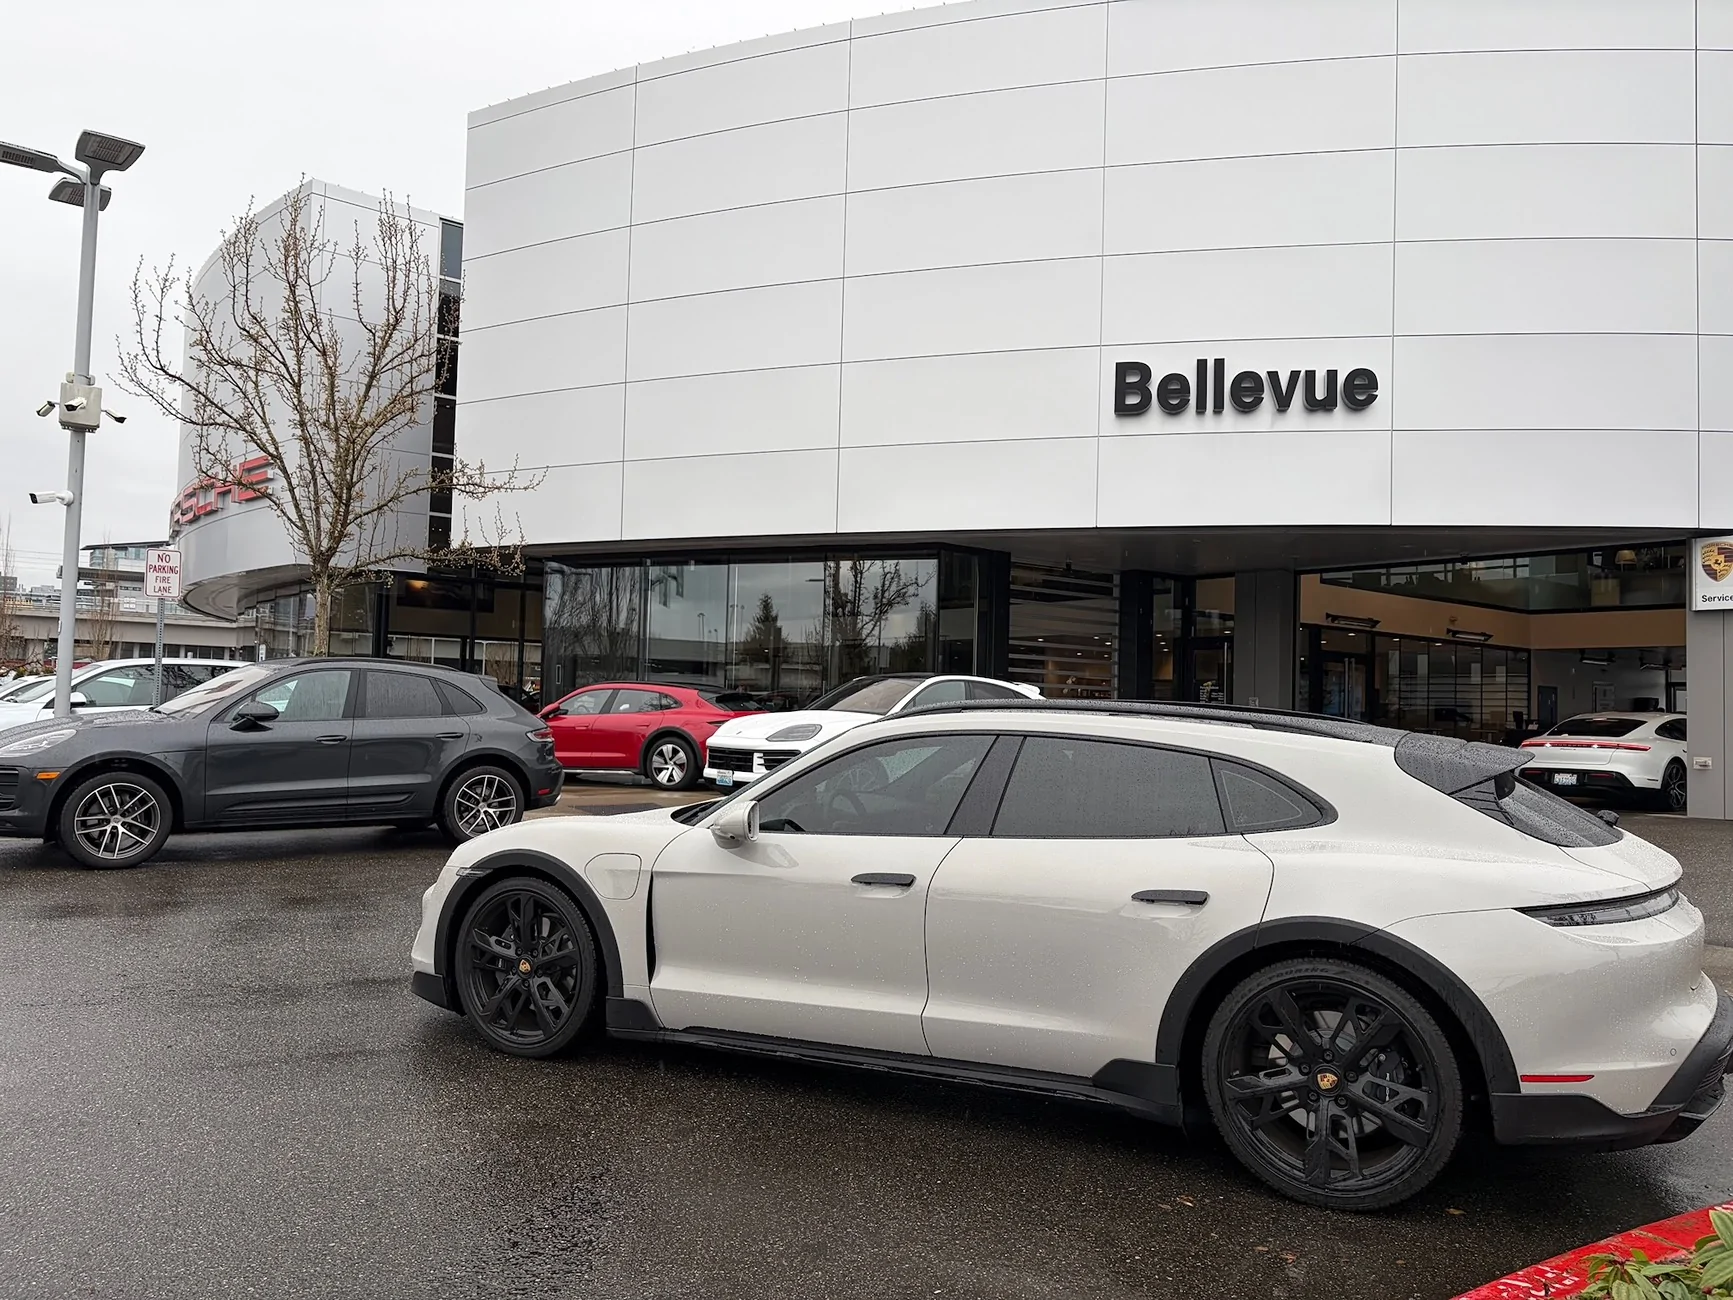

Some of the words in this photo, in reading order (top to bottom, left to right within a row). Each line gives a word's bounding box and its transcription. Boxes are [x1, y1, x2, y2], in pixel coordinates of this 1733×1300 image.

[1114, 357, 1379, 416] Bellevue
[157, 553, 171, 563] NO
[148, 564, 179, 575] PARKING
[155, 575, 172, 584] FIRE
[153, 585, 172, 594] LANE
